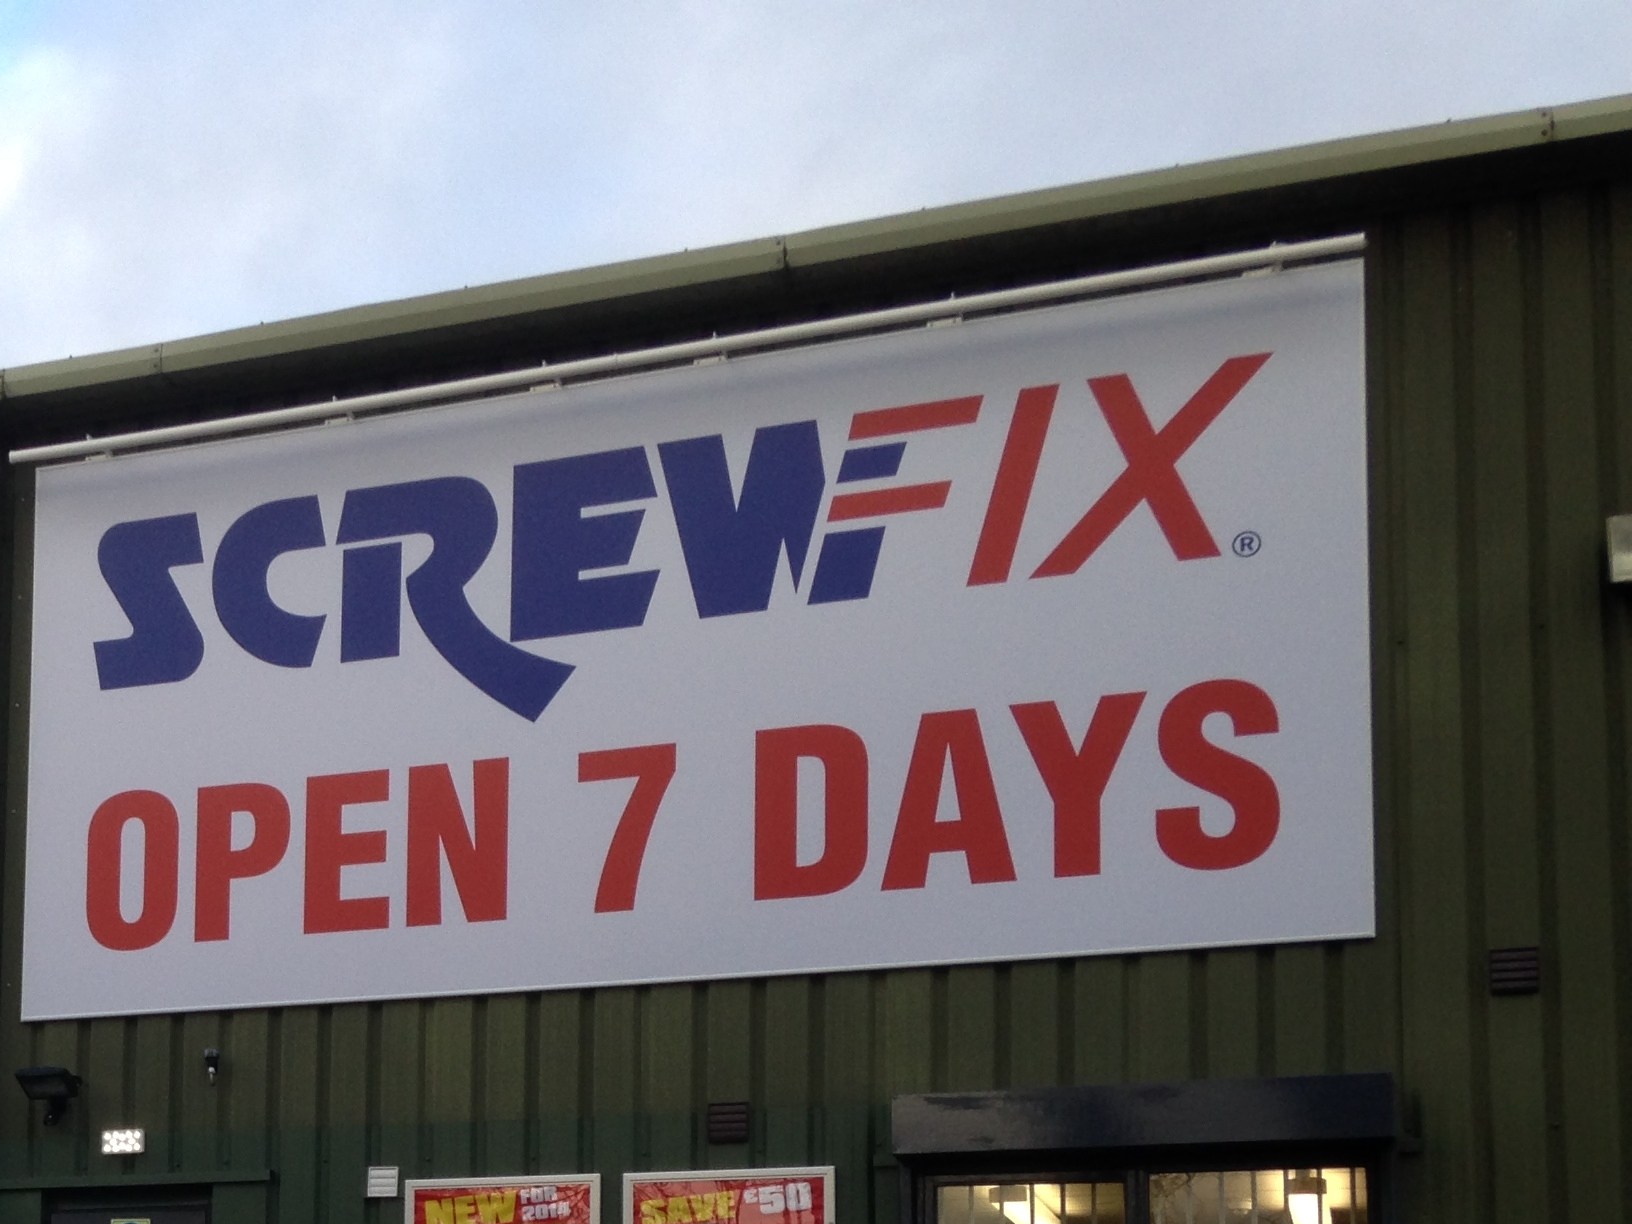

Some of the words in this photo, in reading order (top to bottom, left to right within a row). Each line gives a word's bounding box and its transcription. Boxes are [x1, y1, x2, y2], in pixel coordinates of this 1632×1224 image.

[93, 352, 1272, 723] SCREWFIX
[85, 757, 509, 952] OPEN
[577, 742, 677, 914] 7
[754, 678, 1280, 901] DAYS
[520, 1186, 558, 1204] FOR
[521, 1201, 571, 1221] 2014
[743, 1182, 813, 1216] £50
